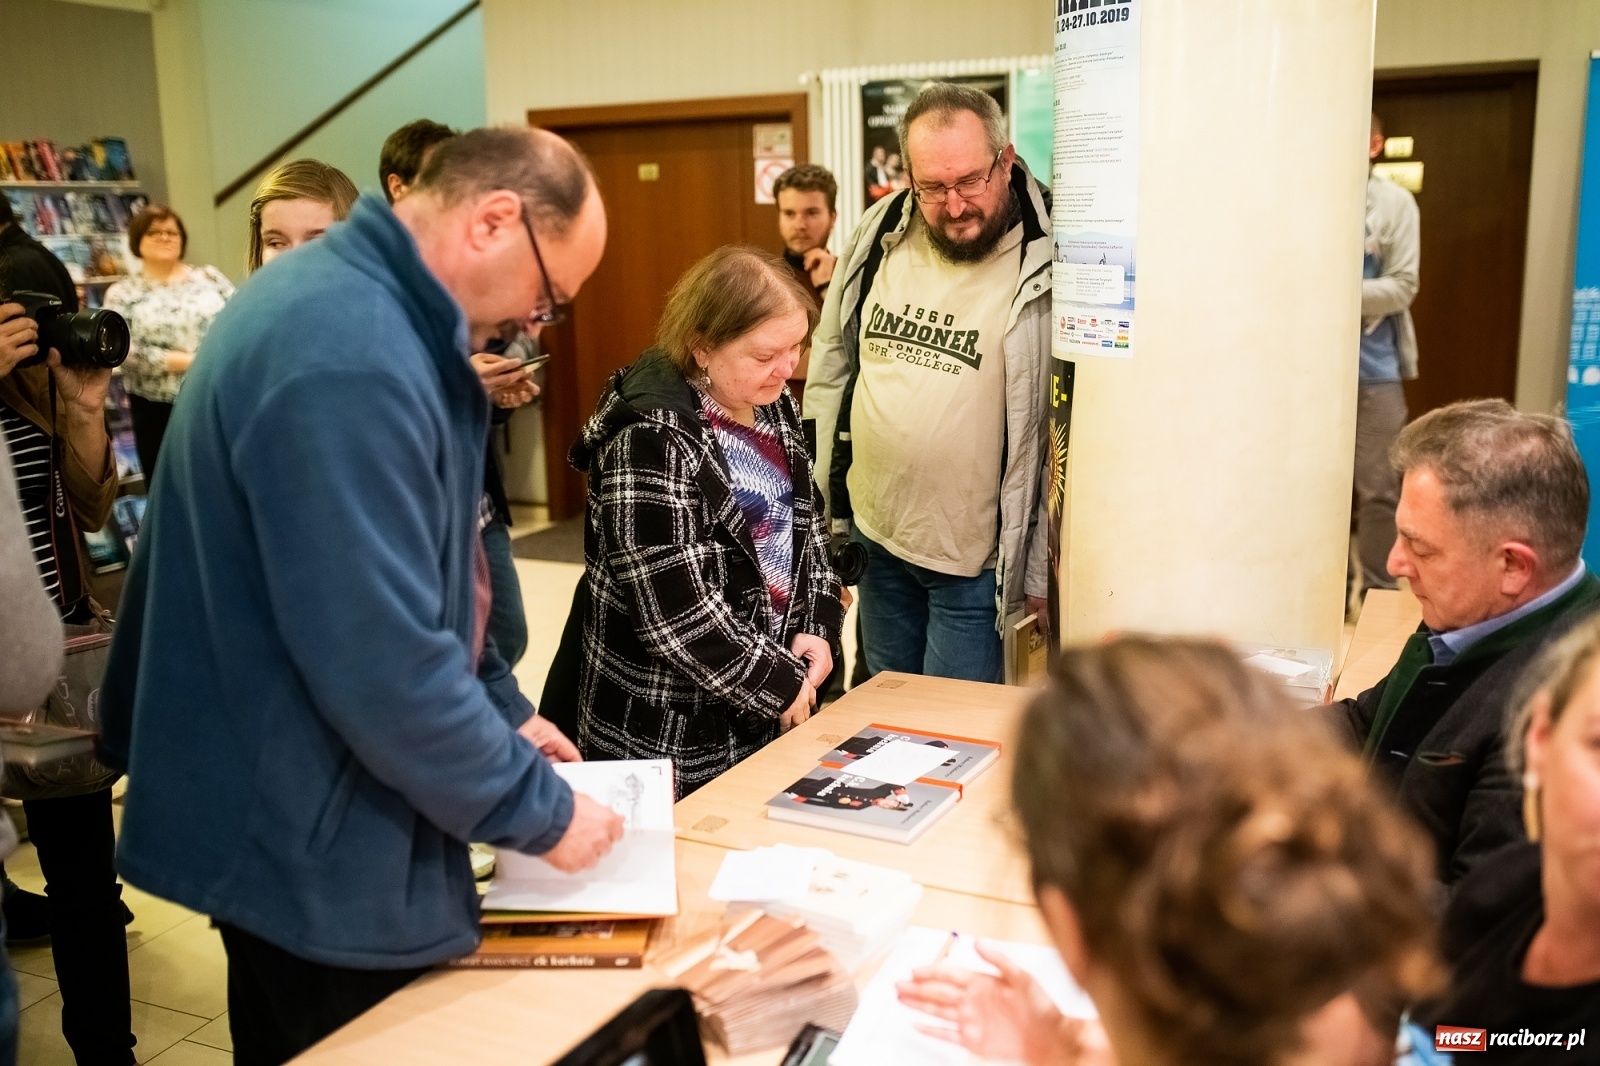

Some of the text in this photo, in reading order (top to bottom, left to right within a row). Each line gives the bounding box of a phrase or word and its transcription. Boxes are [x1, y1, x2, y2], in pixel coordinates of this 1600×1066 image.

[902, 304, 955, 326] 1960
[865, 303, 982, 364] LONDONER
[888, 341, 941, 360] LONDON
[896, 352, 962, 375] COLLEGE
[1050, 373, 1068, 408] E-
[54, 469, 65, 518] Canon
[550, 955, 595, 967] kuchnia
